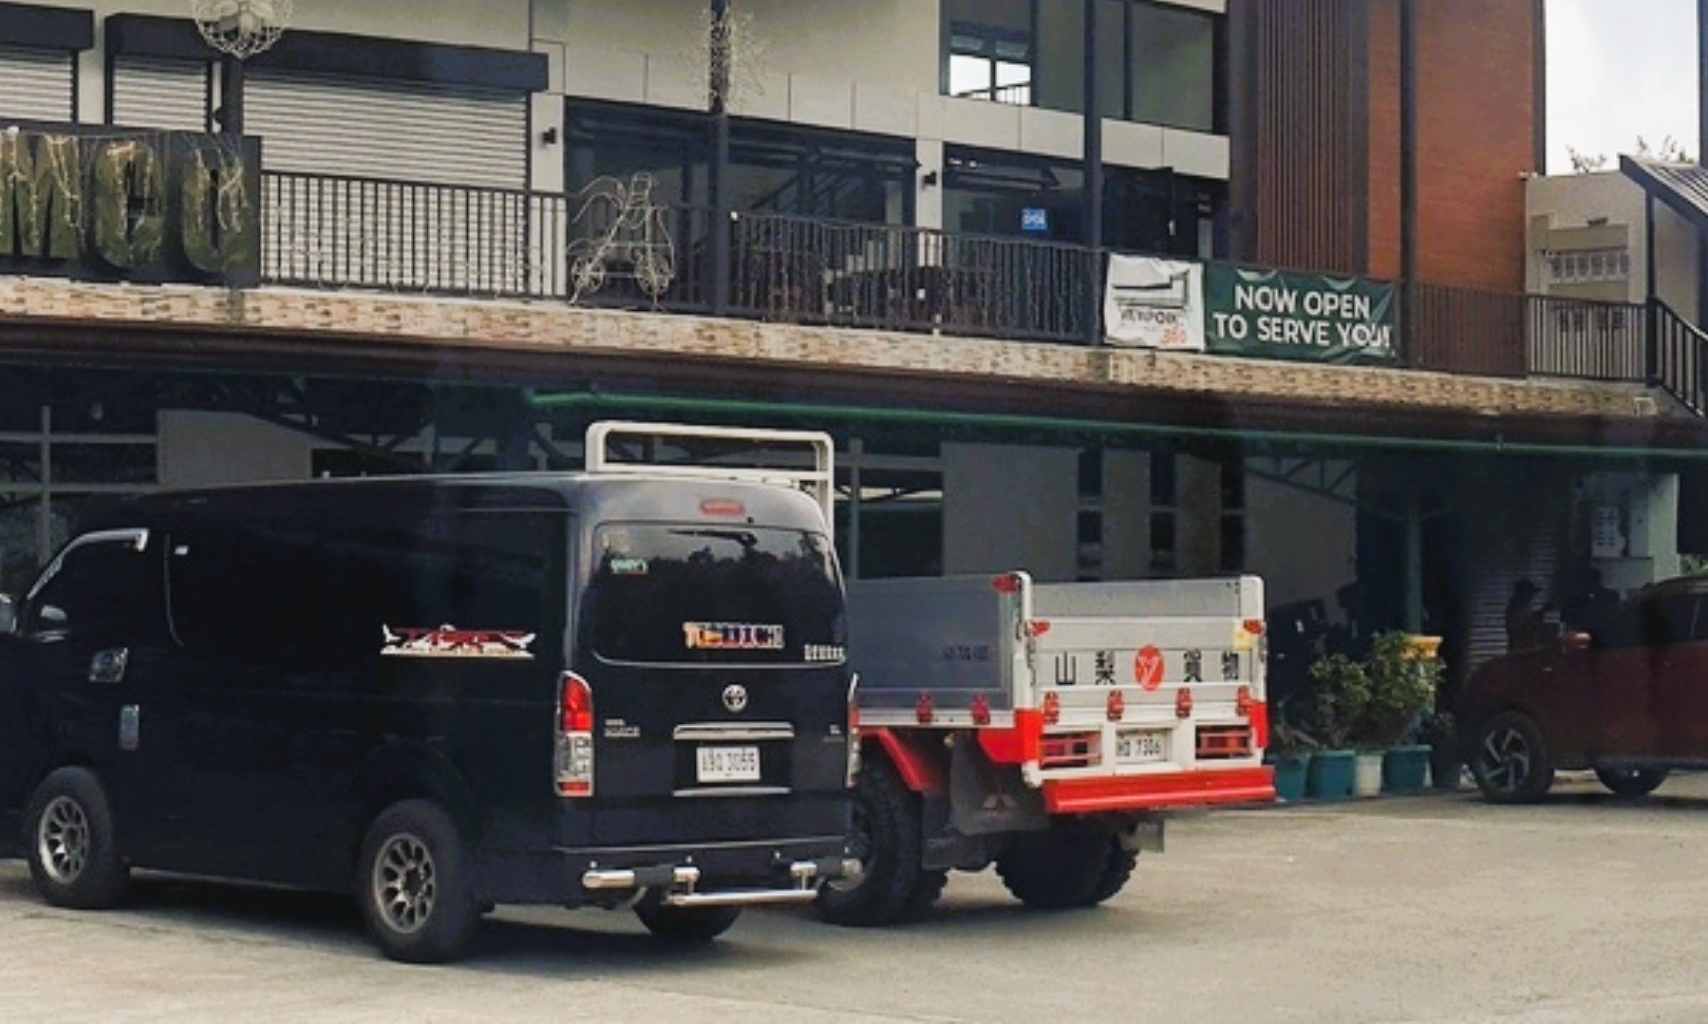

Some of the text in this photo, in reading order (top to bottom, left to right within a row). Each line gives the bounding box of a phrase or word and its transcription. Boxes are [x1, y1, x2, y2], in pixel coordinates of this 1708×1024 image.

[1235, 285, 1370, 319] NOW OPEN
[1212, 311, 1394, 348] TO SERVE YOU!
